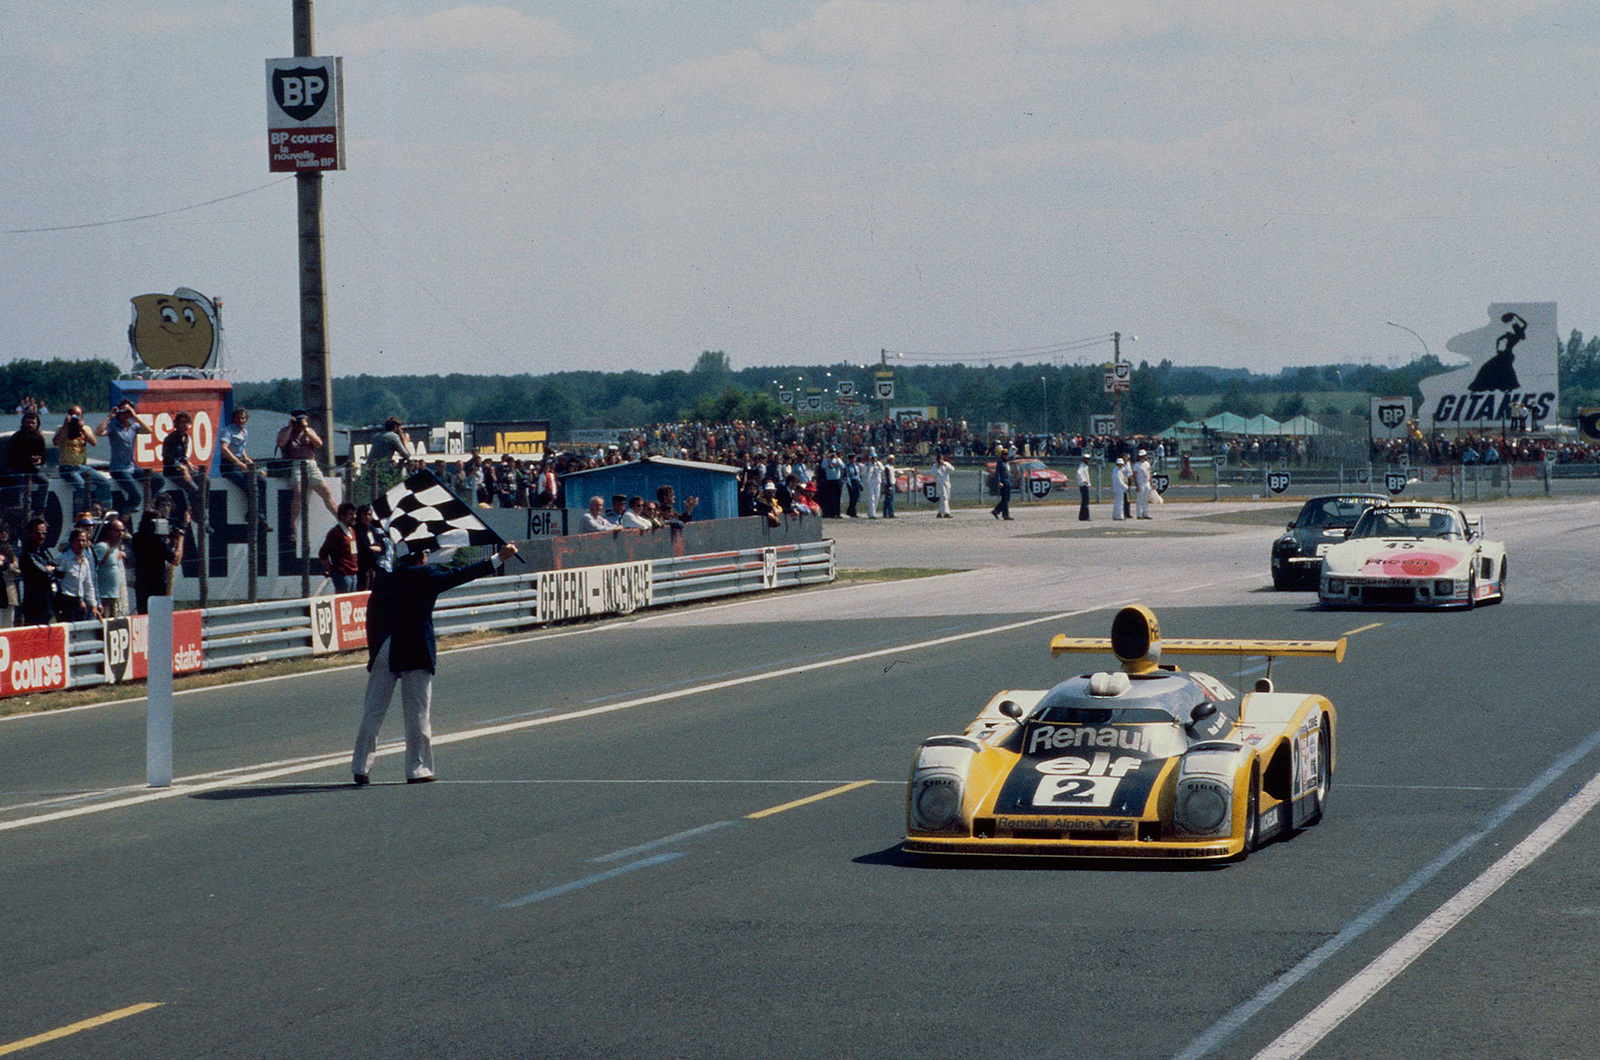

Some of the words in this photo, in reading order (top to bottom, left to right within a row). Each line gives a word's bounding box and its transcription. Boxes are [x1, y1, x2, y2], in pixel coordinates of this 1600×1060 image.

[281, 76, 325, 107] BP
[271, 132, 289, 144] BP
[291, 133, 334, 144] course
[280, 145, 289, 153] la
[274, 151, 315, 160] nouvelle
[296, 157, 320, 167] huile
[321, 158, 335, 167] BP
[1382, 408, 1403, 424] BP
[1098, 421, 1116, 435] BP
[1032, 481, 1050, 494] BP
[1271, 477, 1288, 489] BP
[1388, 478, 1405, 490] BP
[532, 512, 551, 535] elf
[1365, 558, 1428, 566] RICOH
[541, 571, 590, 620] GENERAL
[318, 606, 332, 635] BP
[340, 601, 352, 625] BP
[353, 607, 367, 623] cou
[109, 629, 129, 665] BP
[174, 643, 201, 671] static
[11, 655, 63, 691] course
[1029, 725, 1151, 753] Renaul
[1035, 752, 1142, 777] elf
[1293, 738, 1300, 795] 2
[1052, 778, 1096, 803] 2
[999, 817, 1049, 829] Renault
[1053, 818, 1095, 830] Alpine
[1098, 819, 1135, 829] V6
